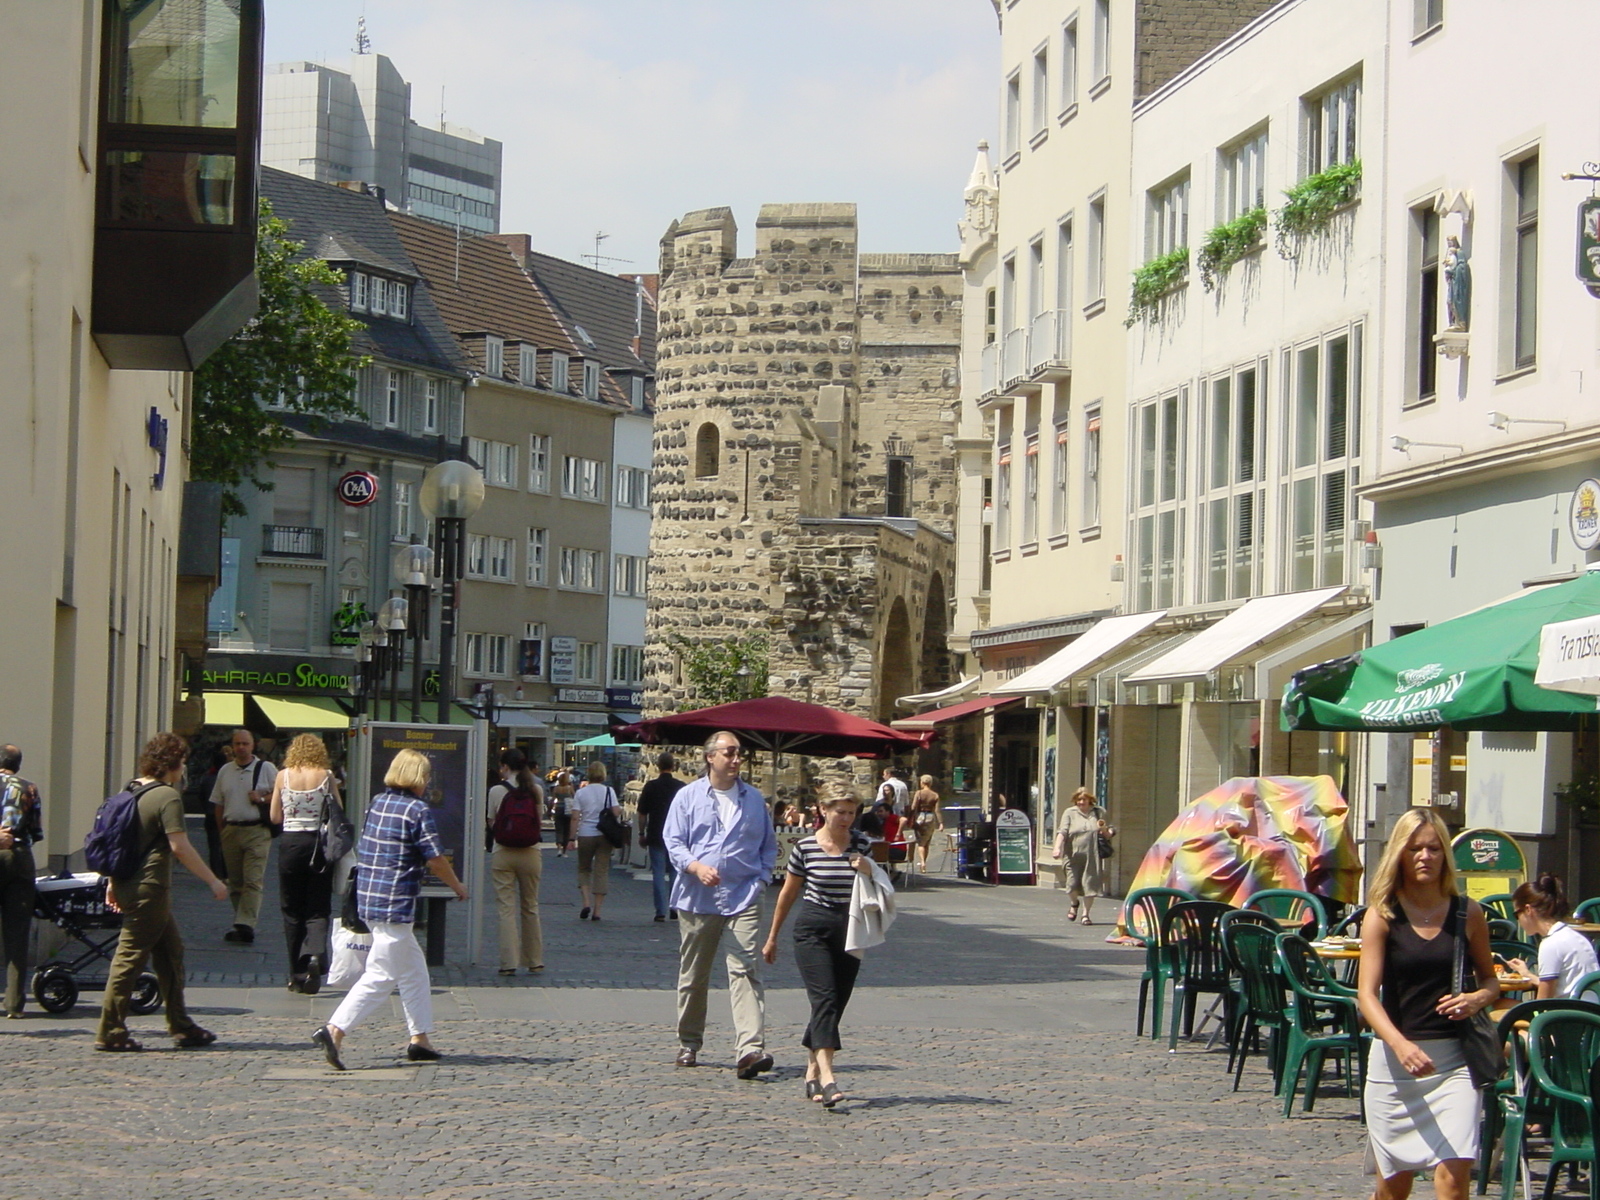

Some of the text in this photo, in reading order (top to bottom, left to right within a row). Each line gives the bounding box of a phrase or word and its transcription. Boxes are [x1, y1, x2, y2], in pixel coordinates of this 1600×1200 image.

[344, 480, 369, 497] C&A
[296, 663, 351, 689] Stroma
[1359, 671, 1465, 717] KILKENNY
[1361, 708, 1444, 727] IRISH BEER
[406, 730, 434, 740] Bonner
